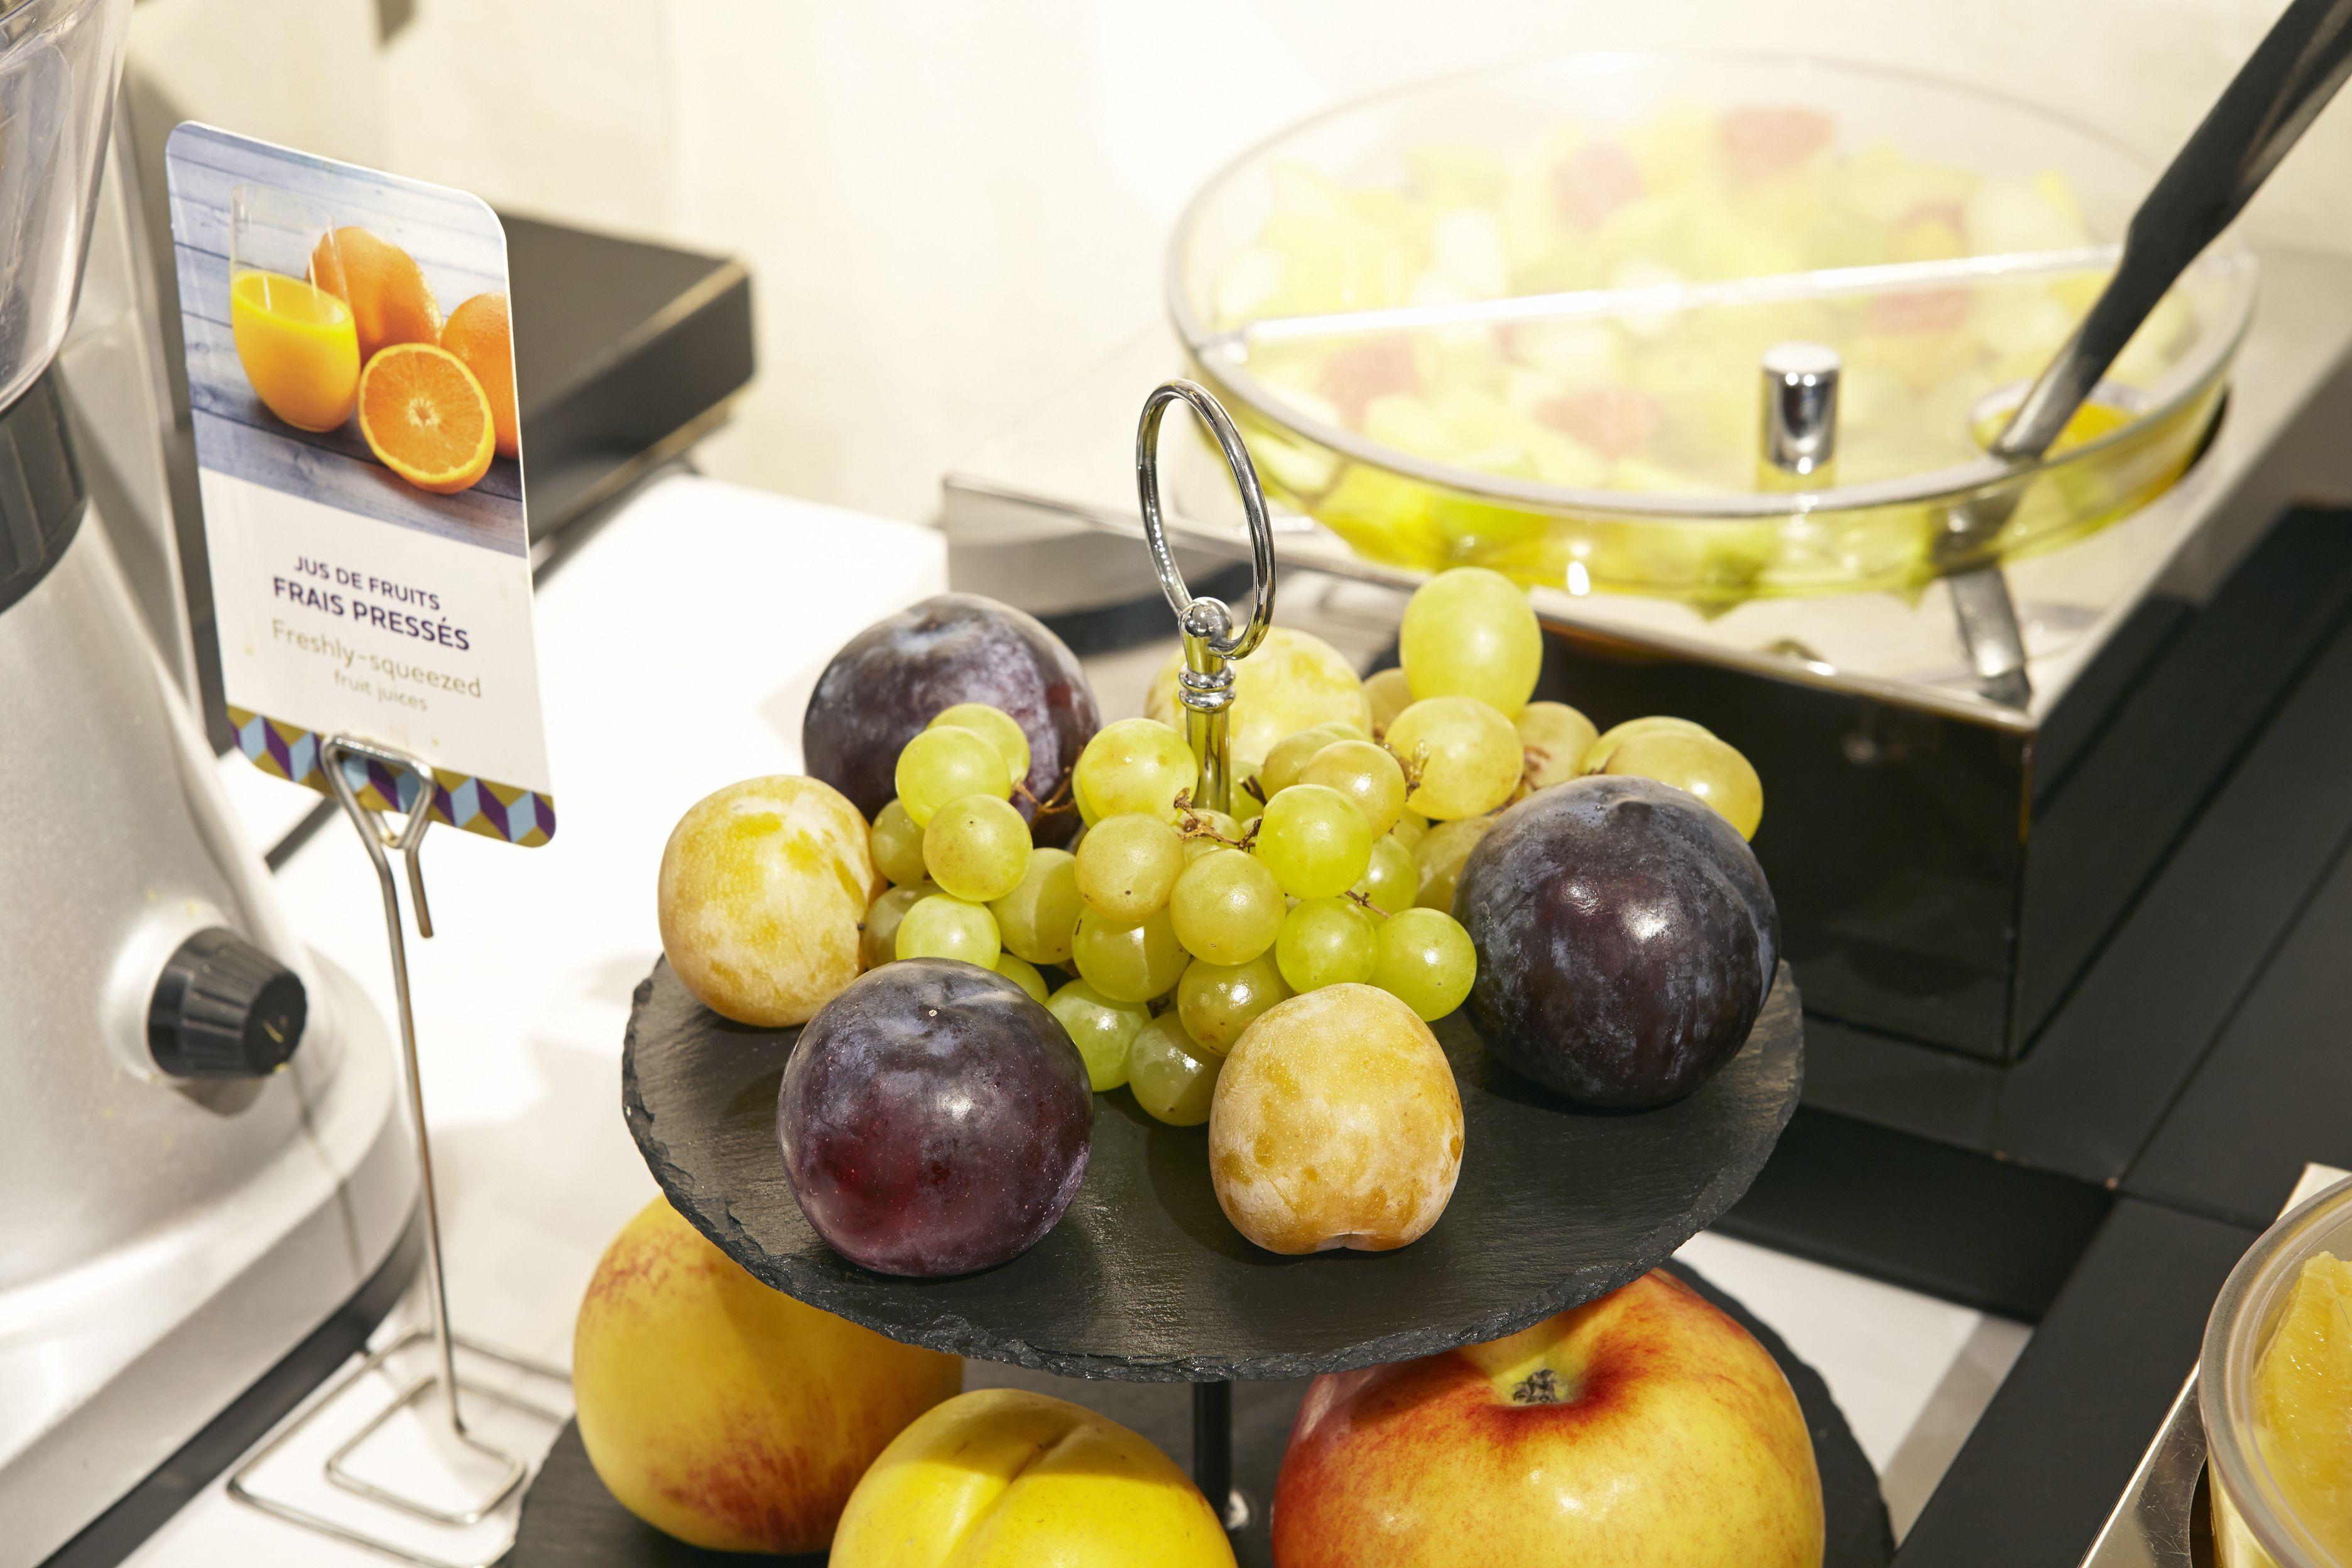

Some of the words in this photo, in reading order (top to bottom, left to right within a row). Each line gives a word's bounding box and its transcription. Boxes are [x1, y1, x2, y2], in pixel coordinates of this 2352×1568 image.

[273, 577, 344, 616] FRAIS
[353, 601, 470, 651] PRESSÉS
[295, 556, 329, 579] JUS
[336, 568, 363, 590] DE
[369, 577, 440, 611] FRUITS
[271, 618, 481, 699] Freshly-squeezed
[334, 669, 371, 695] fruit
[377, 683, 428, 711] juices
